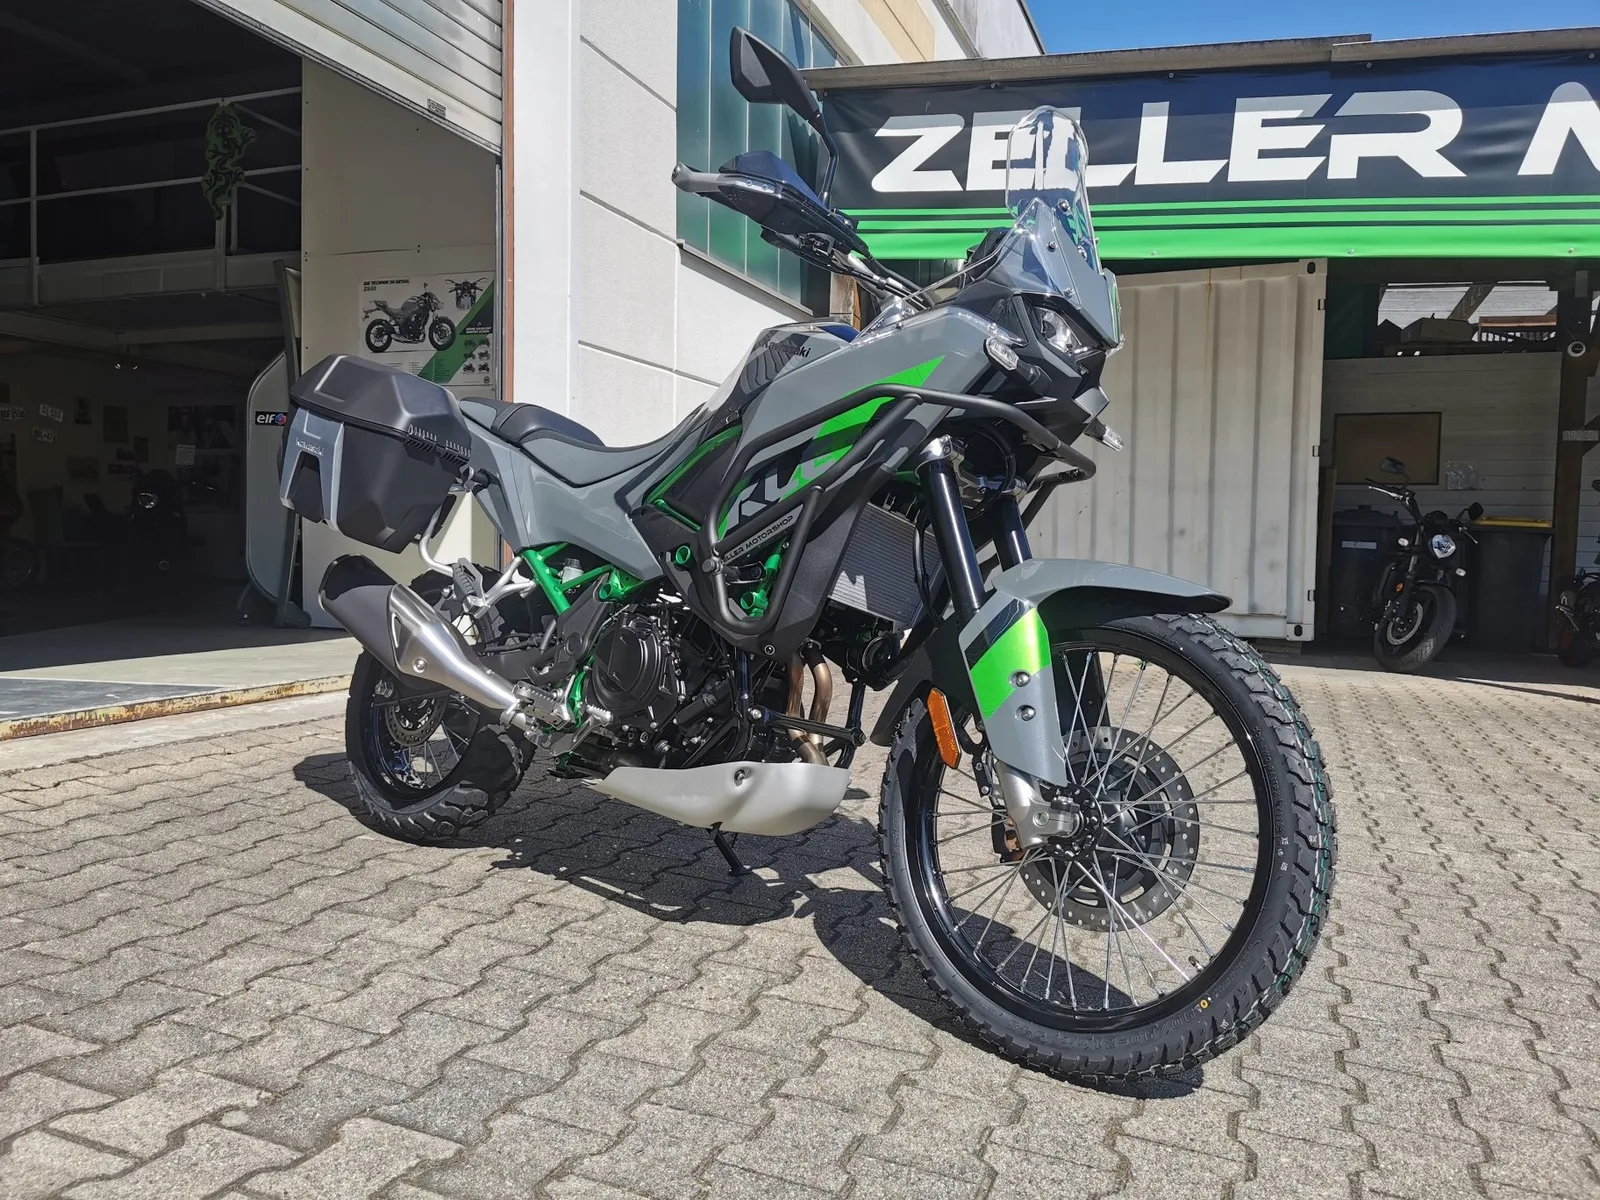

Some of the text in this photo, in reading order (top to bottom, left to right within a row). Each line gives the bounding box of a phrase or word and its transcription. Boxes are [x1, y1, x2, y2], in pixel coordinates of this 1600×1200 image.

[872, 90, 1467, 192] ZELLER
[256, 413, 275, 424] elf
[745, 515, 794, 550] MOTORSHOP
